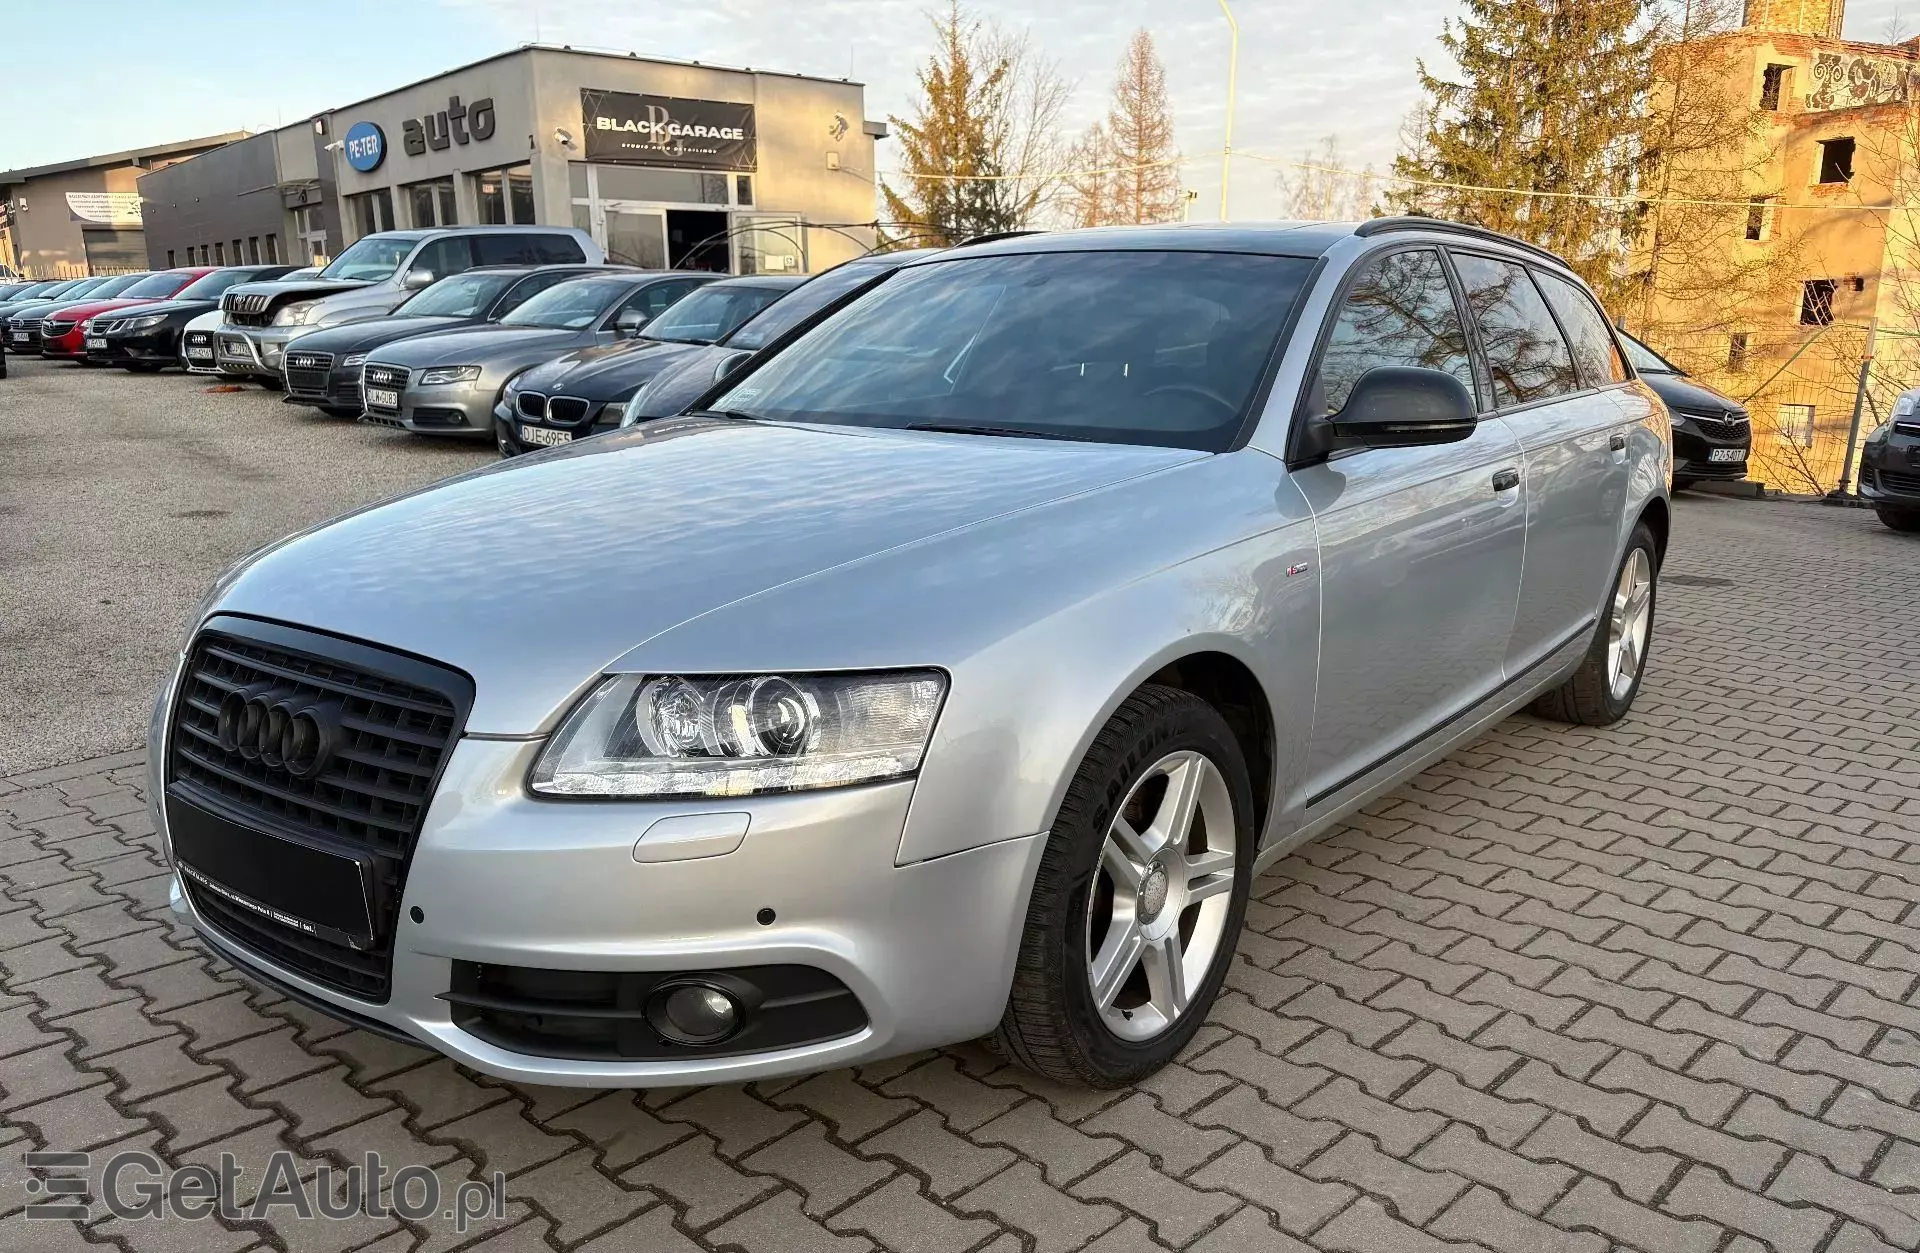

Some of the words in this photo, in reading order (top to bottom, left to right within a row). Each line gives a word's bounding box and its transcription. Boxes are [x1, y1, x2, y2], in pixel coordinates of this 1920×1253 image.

[402, 95, 496, 157] auto
[596, 117, 665, 135] BLACK
[667, 123, 744, 140] GARAGE
